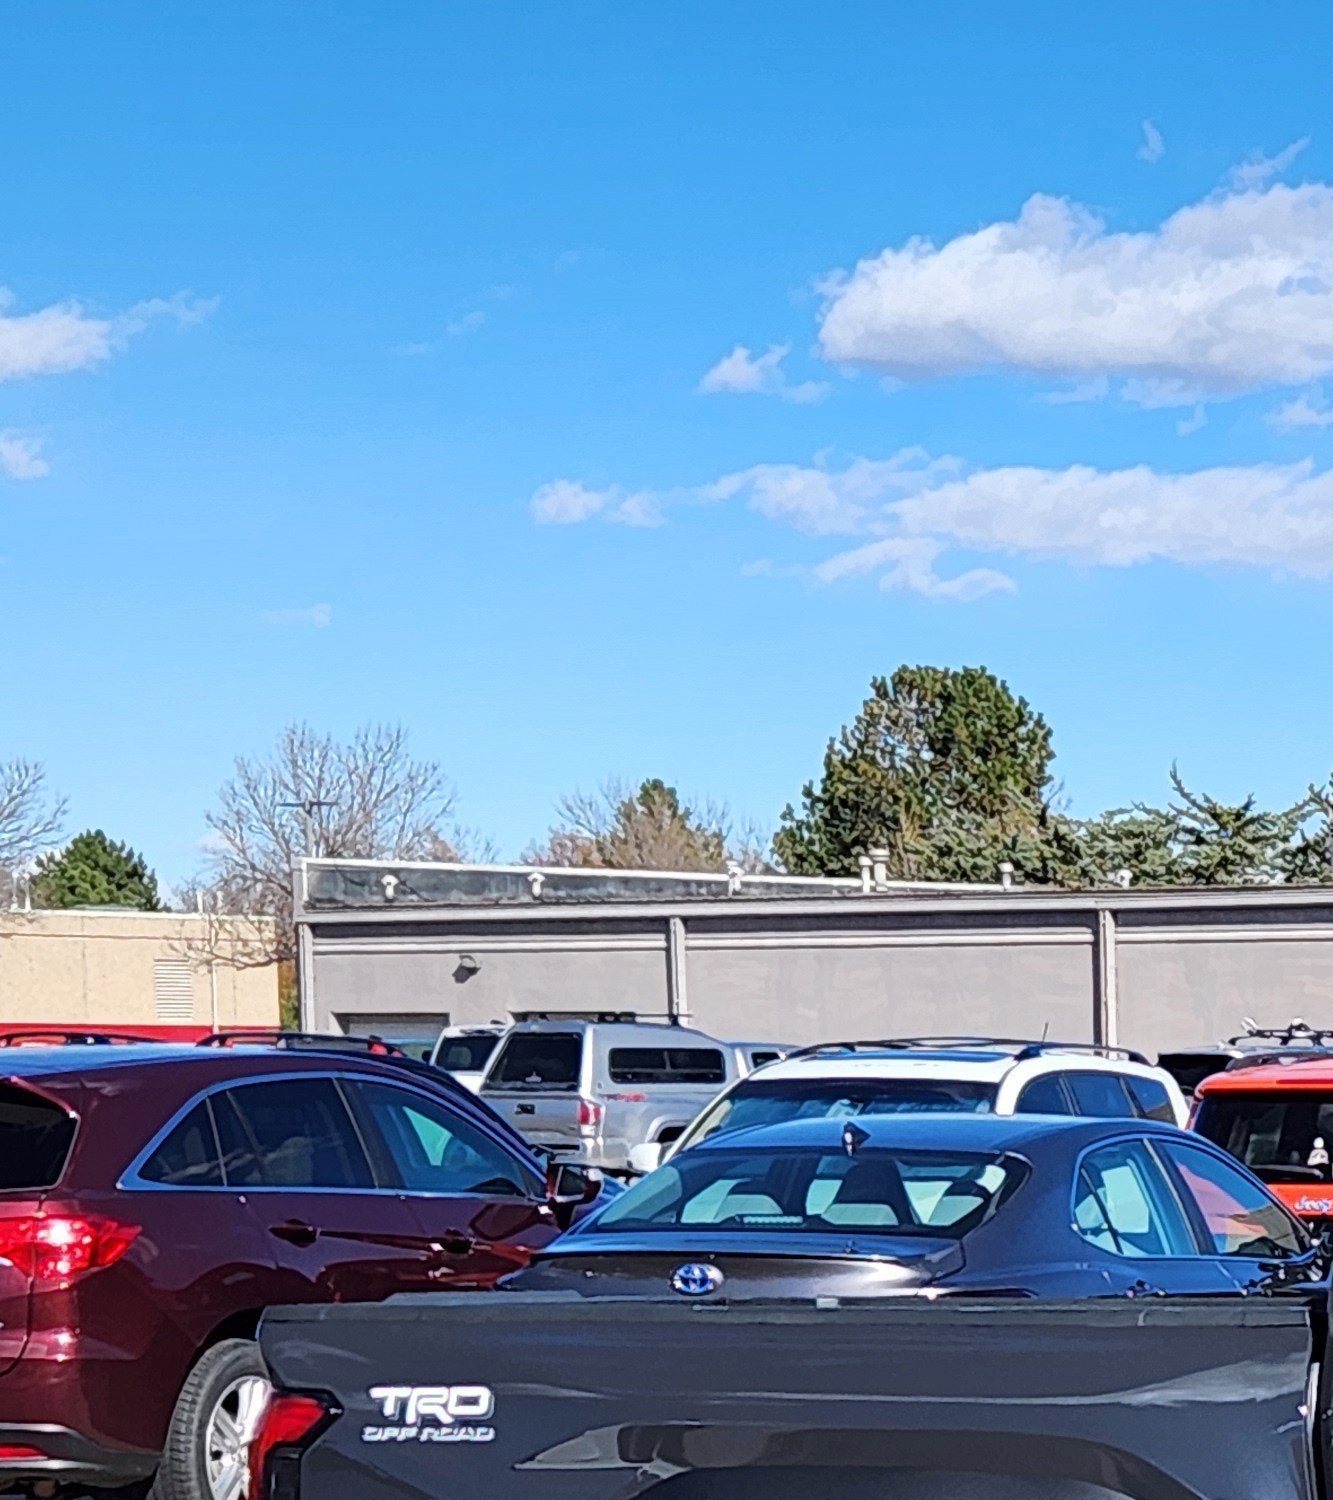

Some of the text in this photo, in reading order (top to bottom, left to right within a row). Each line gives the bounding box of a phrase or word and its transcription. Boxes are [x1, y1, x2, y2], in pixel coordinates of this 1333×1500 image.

[369, 1386, 495, 1426] TRD
[361, 1426, 496, 1442] OFF ROAD
